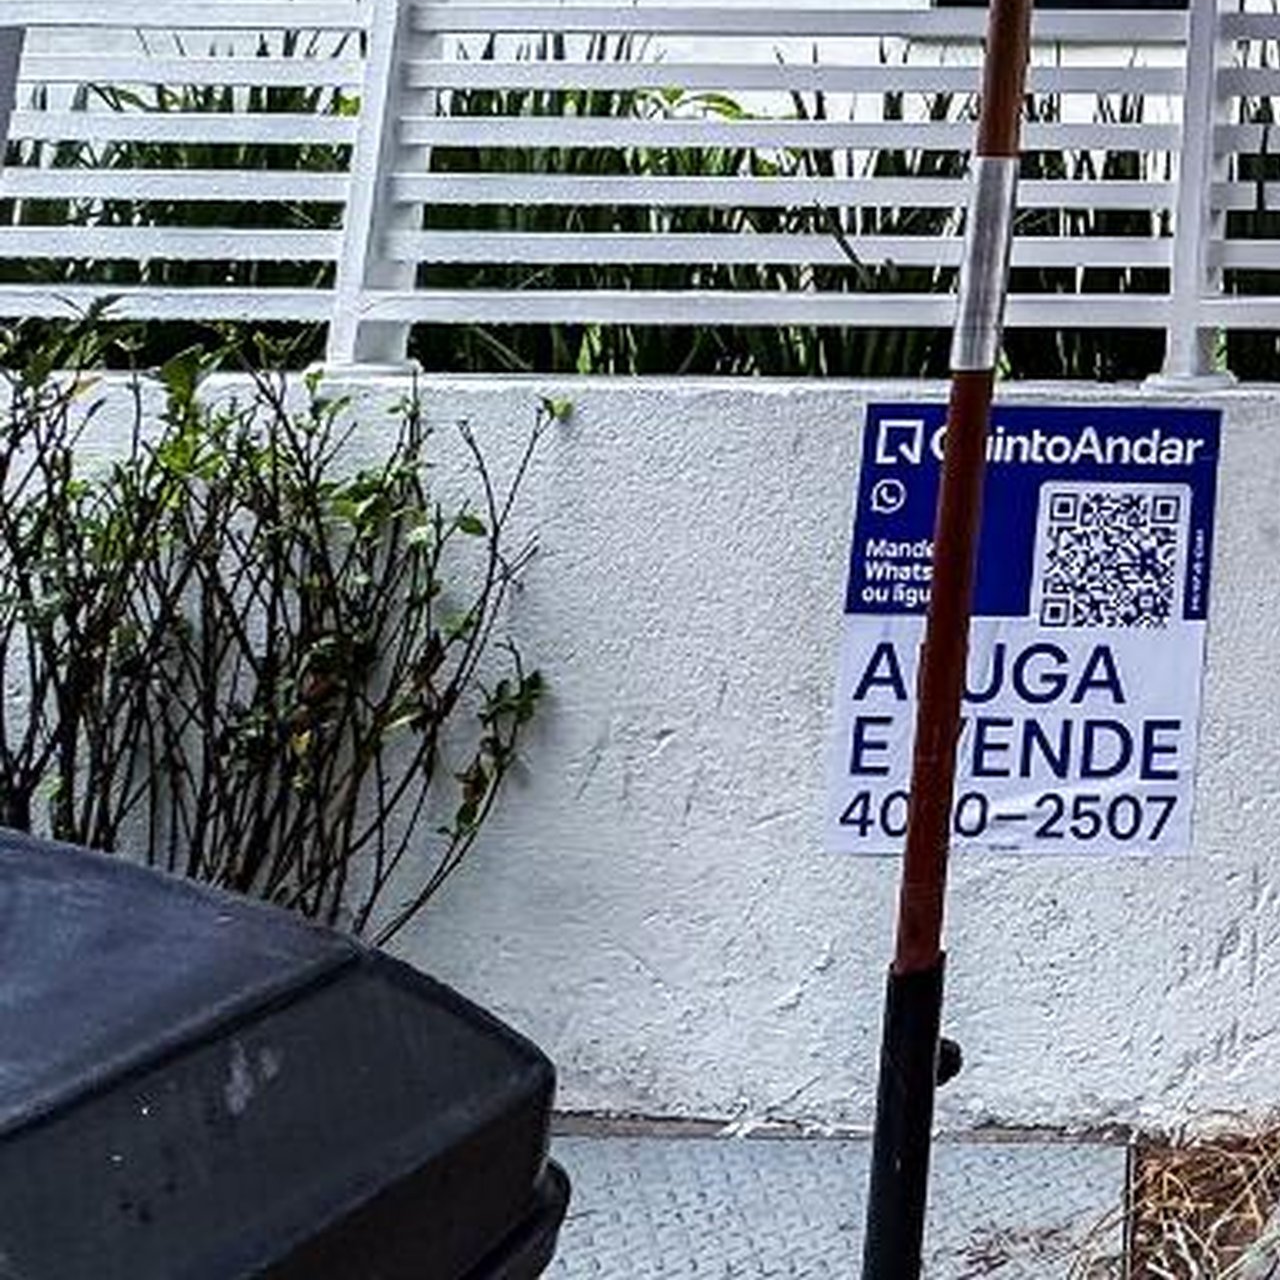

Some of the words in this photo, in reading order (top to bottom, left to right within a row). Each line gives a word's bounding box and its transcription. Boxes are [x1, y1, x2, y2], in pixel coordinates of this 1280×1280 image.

[930, 426, 1205, 465] intoAndar
[864, 560, 935, 582] Whats
[861, 587, 889, 603] ou
[892, 583, 932, 608] ligu
[852, 641, 1127, 705] AUGA
[849, 715, 894, 777] E
[839, 789, 1178, 842] 400-2507
